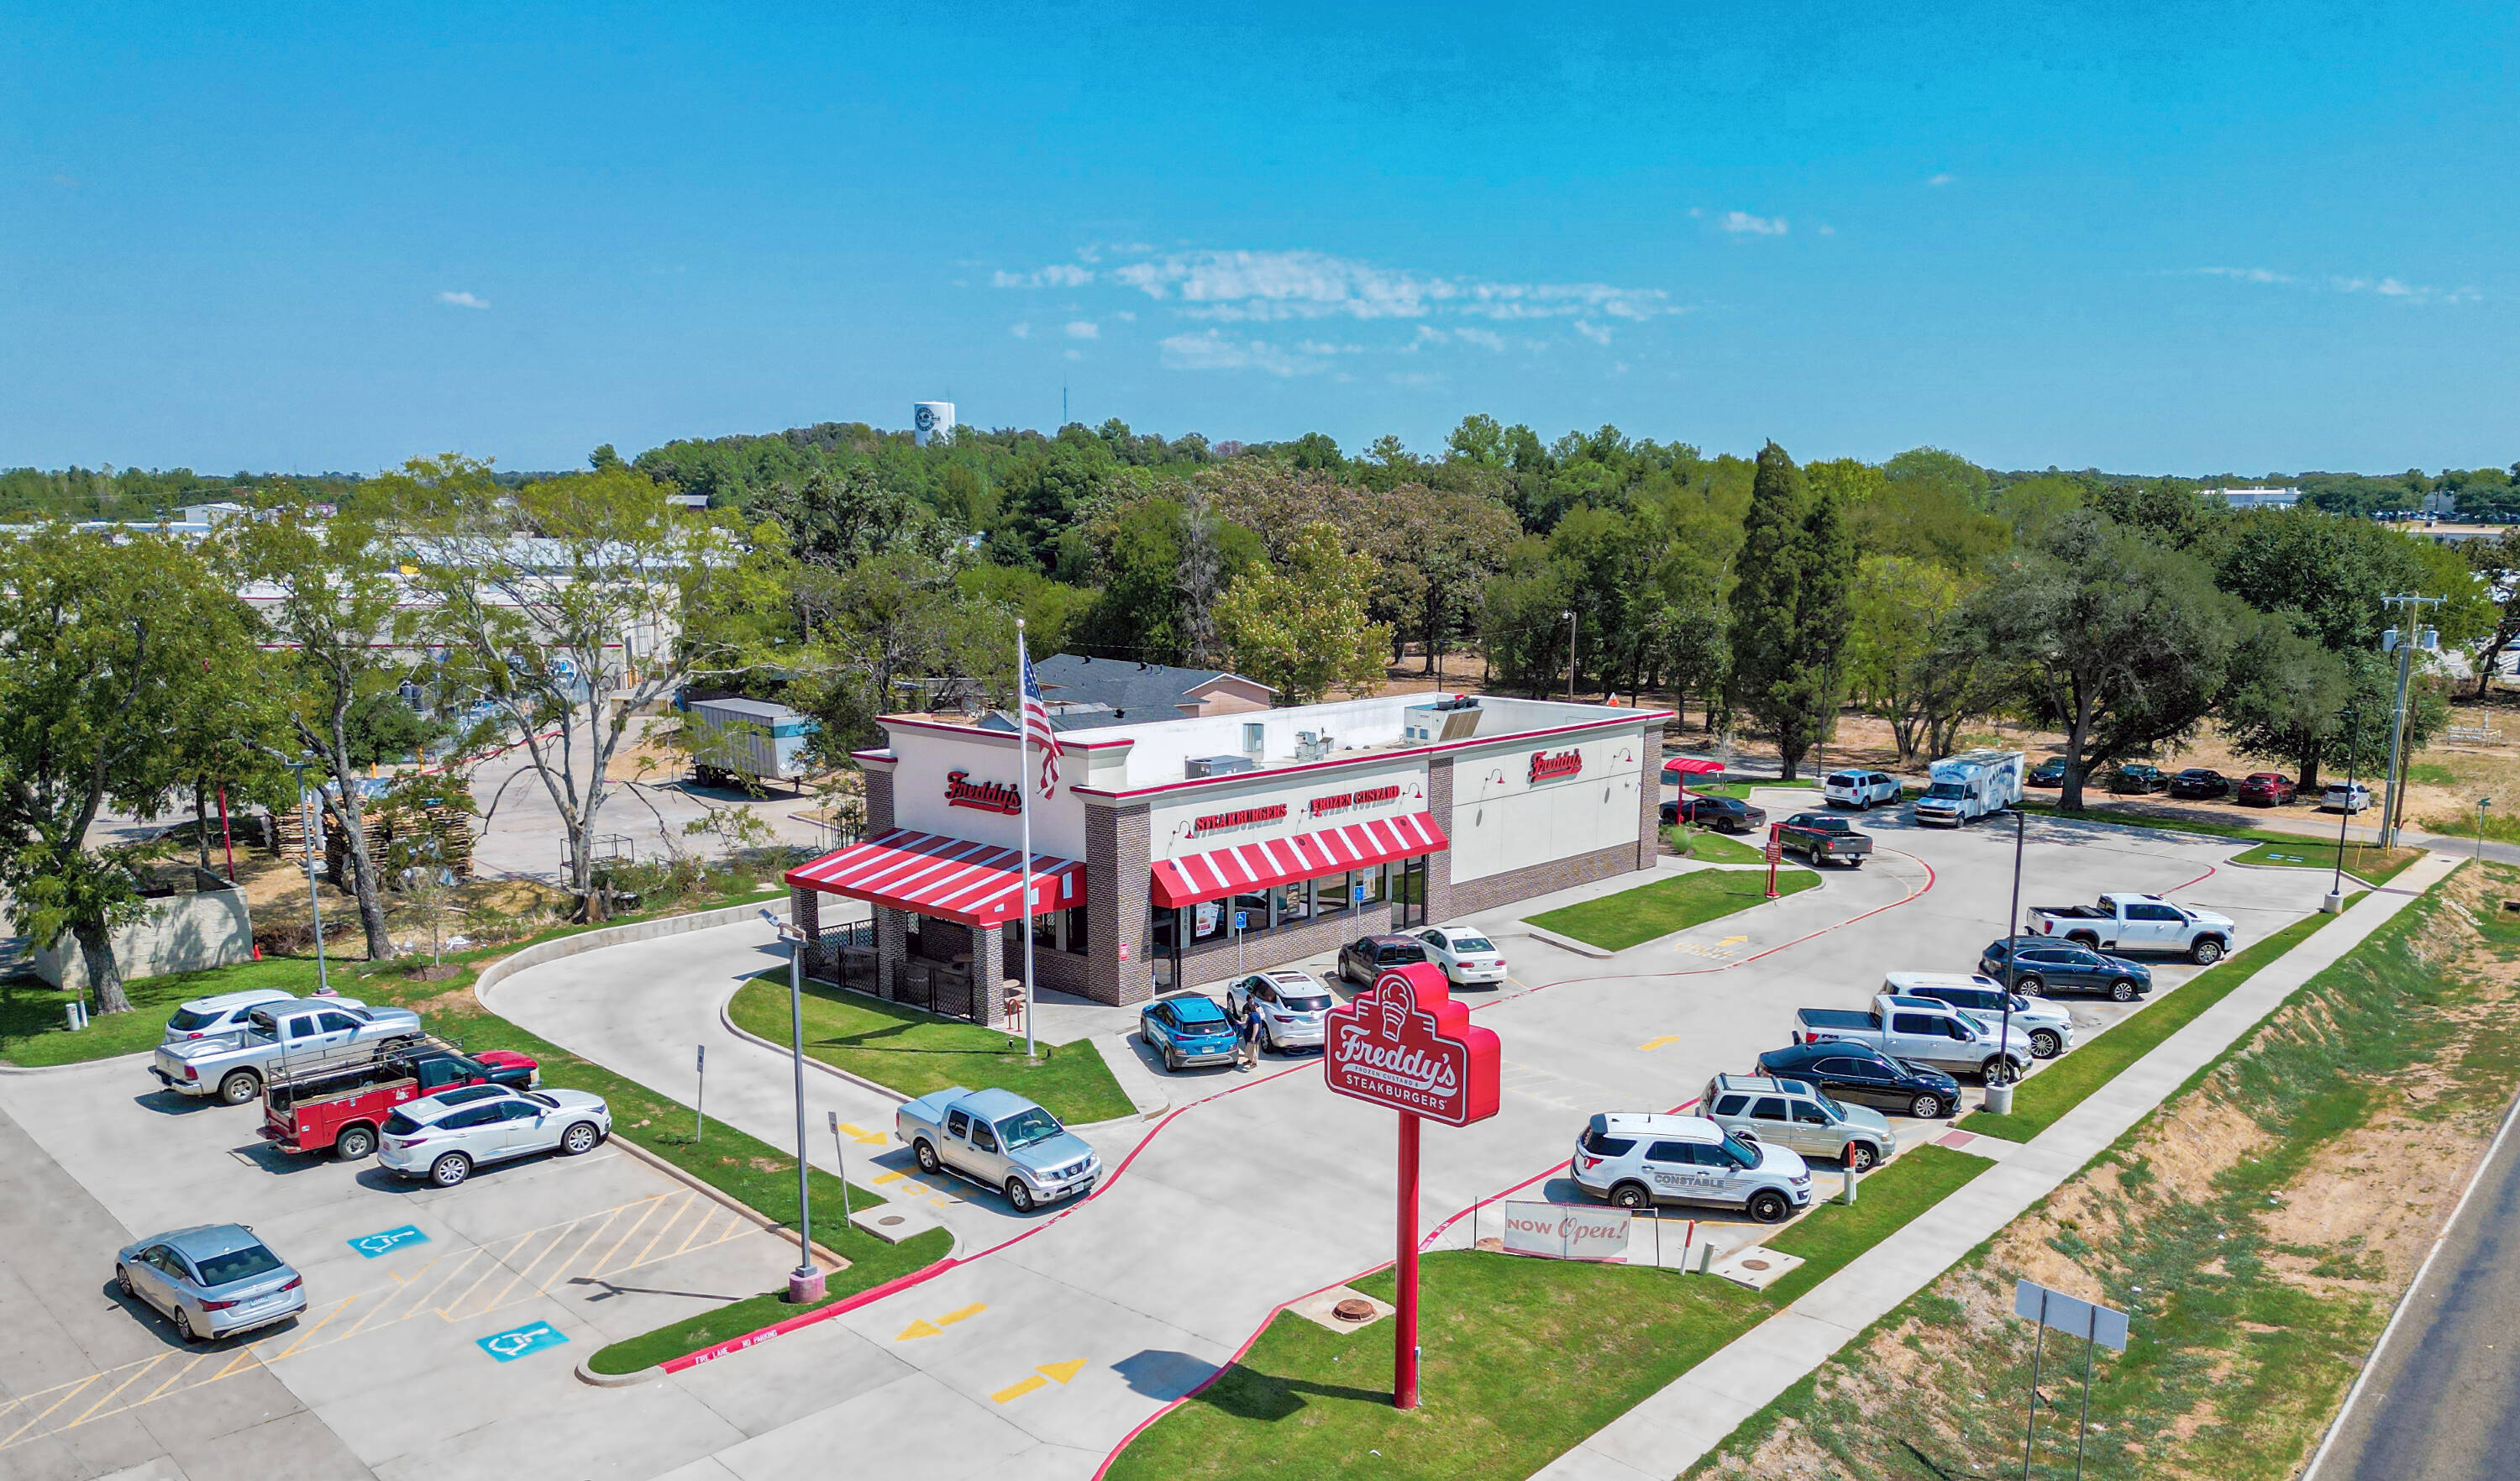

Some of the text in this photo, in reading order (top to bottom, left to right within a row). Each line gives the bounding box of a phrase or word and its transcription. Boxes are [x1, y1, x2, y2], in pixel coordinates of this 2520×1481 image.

[1527, 748, 1583, 783] Freddy's
[944, 770, 1022, 816] Freddy's
[1310, 785, 1400, 812] FROZEN CUSTARD
[1195, 803, 1288, 832] STEAKBURGERS
[1335, 1024, 1457, 1097] Freddy's
[1354, 1065, 1381, 1078] FROZEN
[1383, 1073, 1413, 1087] CUSTARD
[1346, 1074, 1446, 1111] STEAKBURGERS
[1654, 1174, 1725, 1190] CONSTABLE
[1507, 1217, 1628, 1245] NOW Open!
[695, 1329, 778, 1365] FIRE LANE NO PARKING
